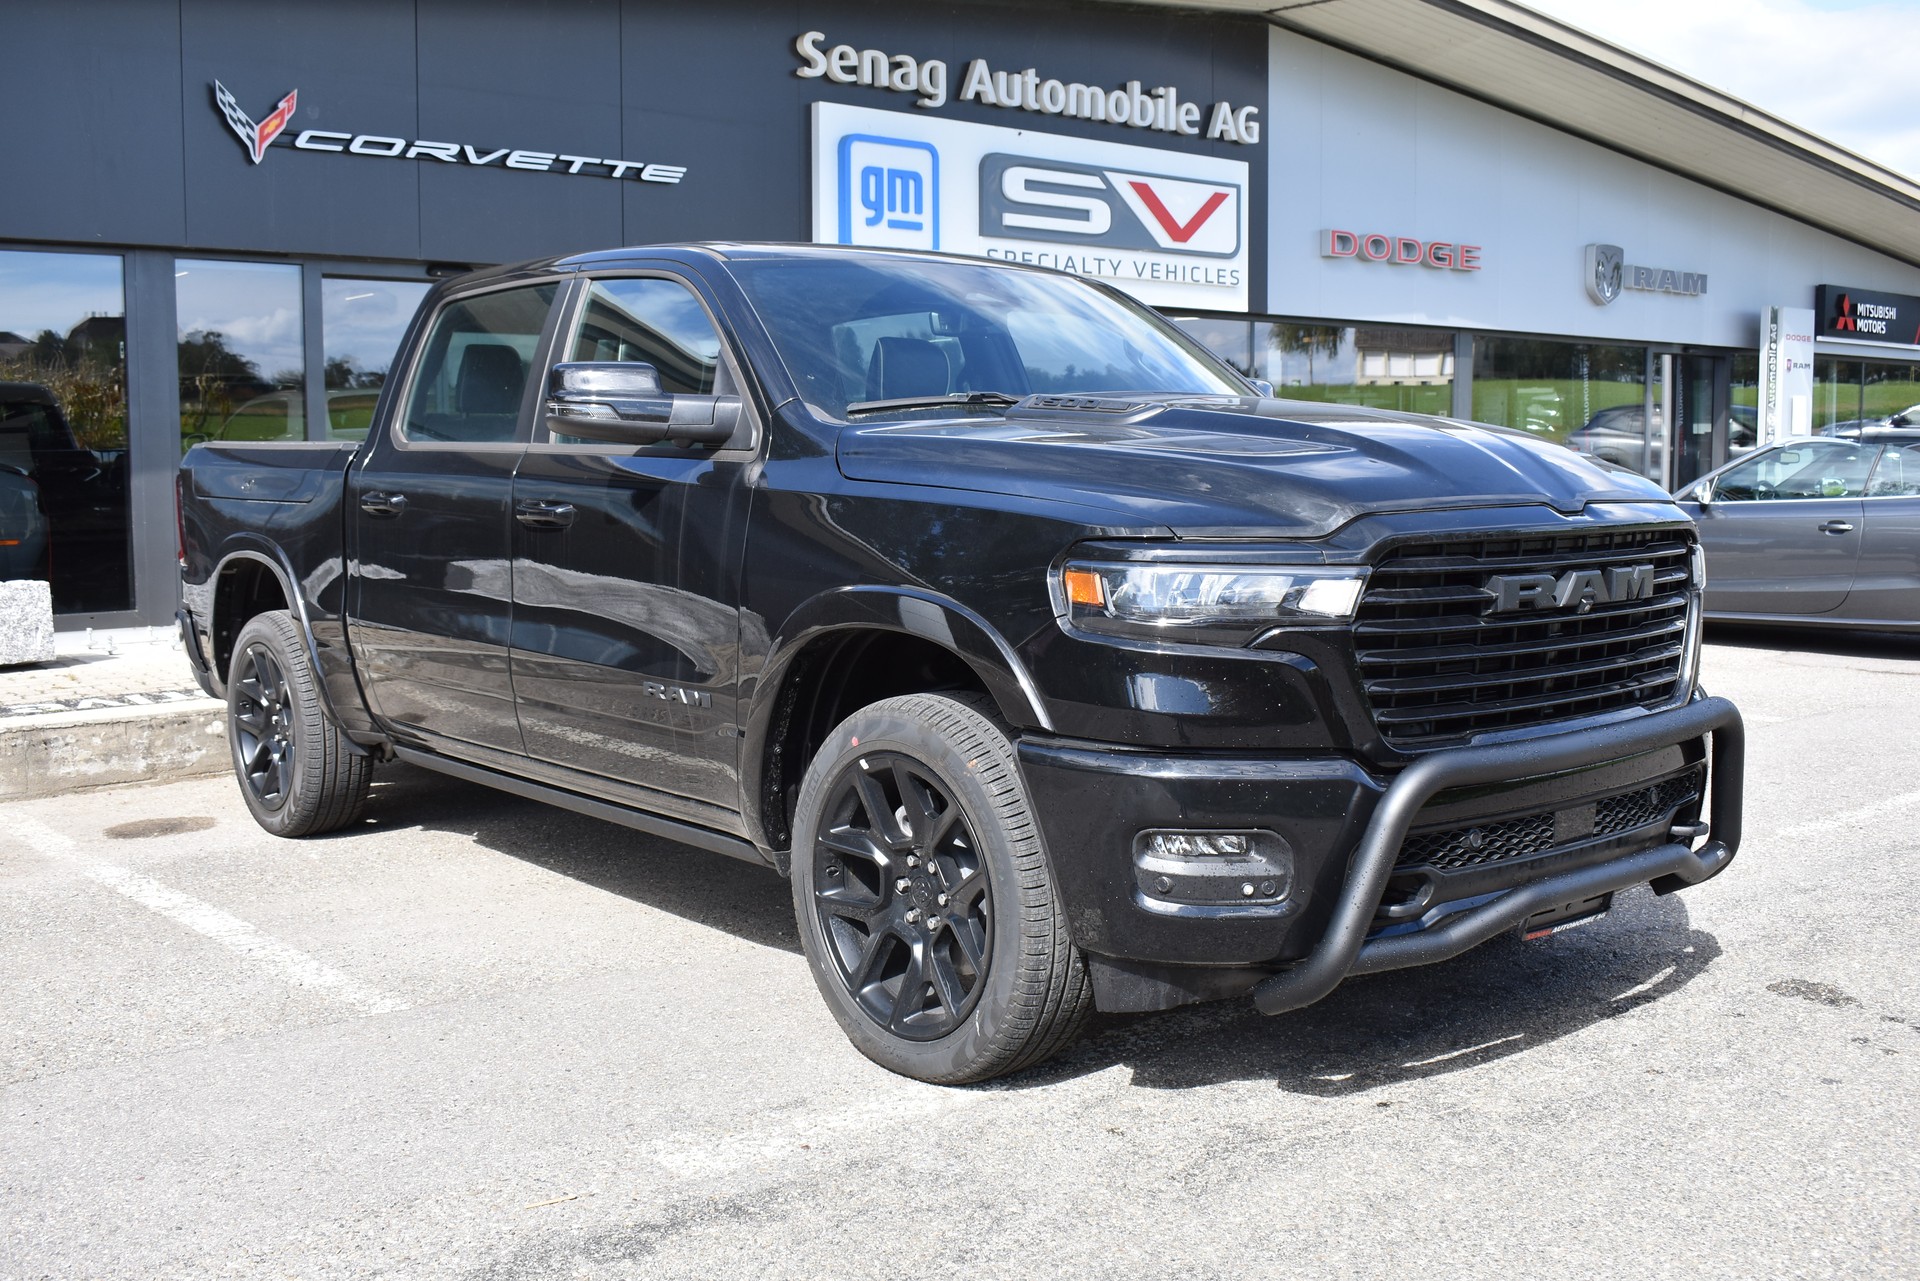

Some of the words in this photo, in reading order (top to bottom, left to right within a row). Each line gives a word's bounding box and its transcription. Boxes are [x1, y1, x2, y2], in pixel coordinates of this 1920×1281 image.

[796, 30, 947, 107] Senag
[959, 58, 1201, 135] Automobile
[1206, 100, 1260, 145] AG
[294, 129, 688, 184] CORVETTE
[860, 165, 924, 229] gm
[1002, 165, 1231, 243] SV
[1327, 229, 1482, 271] DODGE
[1133, 260, 1241, 286] VEHICLES
[1630, 264, 1708, 296] RAM
[1856, 318, 1886, 335] MOTORS
[1857, 302, 1897, 320] MITSUBISHI
[1785, 333, 1812, 343] DODGE
[1792, 362, 1811, 370] RAM
[1488, 564, 1655, 612] RAM
[642, 681, 713, 709] RAM
